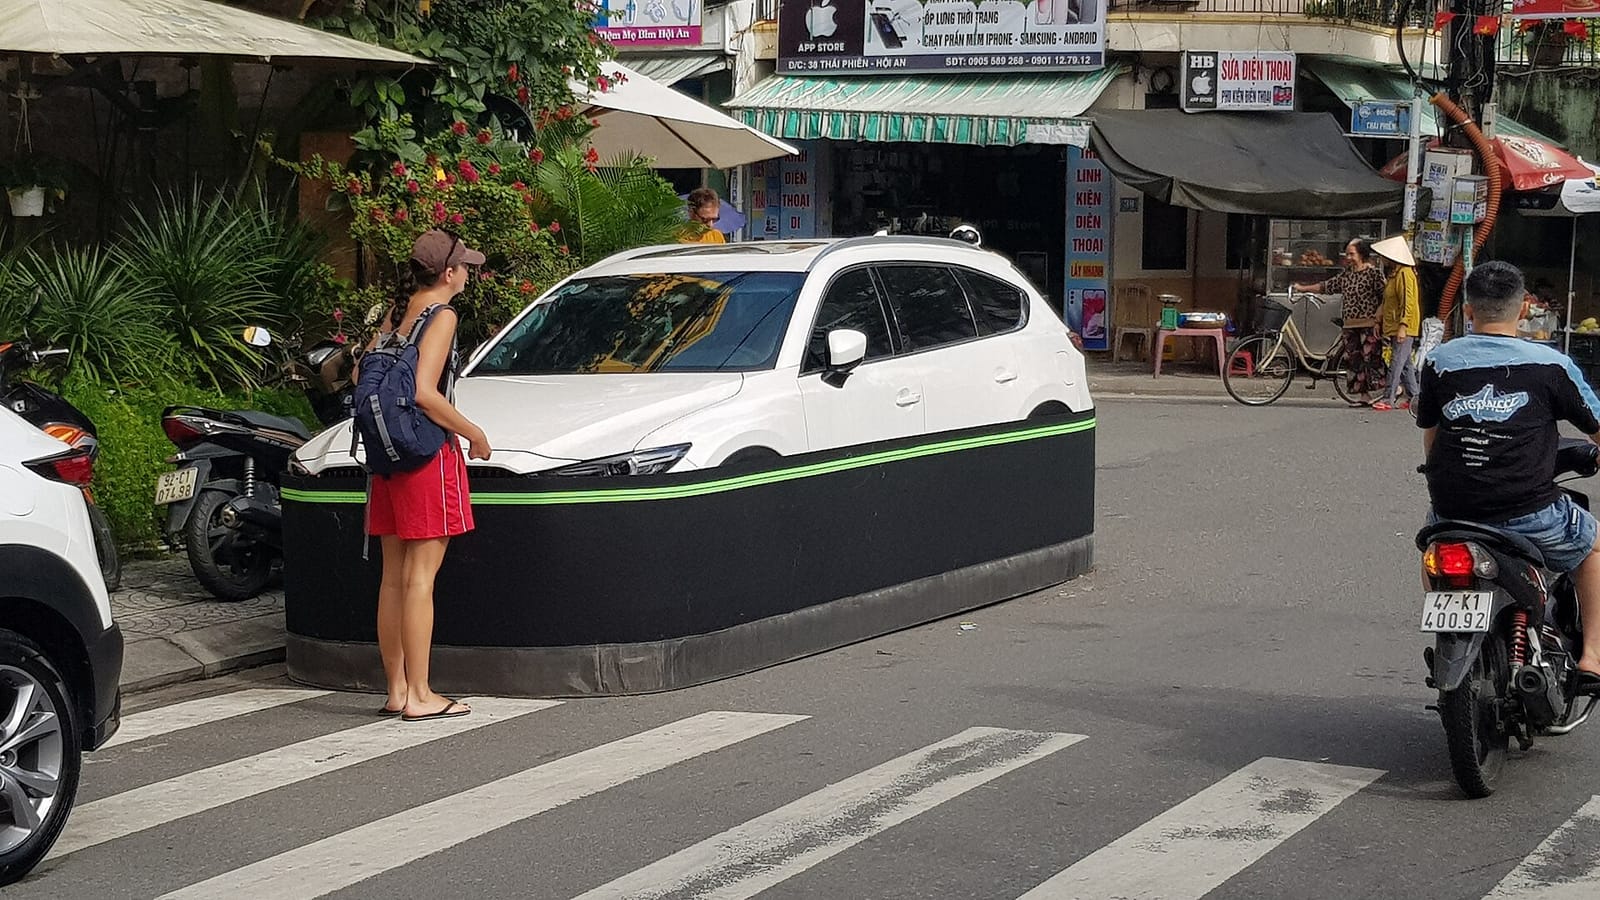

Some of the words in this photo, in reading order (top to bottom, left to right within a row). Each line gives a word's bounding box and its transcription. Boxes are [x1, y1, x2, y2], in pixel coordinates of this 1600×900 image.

[975, 11, 999, 24] TRANG
[986, 33, 1013, 46] IPHONE
[1020, 32, 1057, 45] SAMSUNG
[1064, 31, 1097, 45] ANDROID
[798, 43, 816, 53] APP
[817, 42, 845, 52] STORE
[893, 58, 906, 67] AN
[1031, 55, 1051, 65] 0901
[1190, 55, 1215, 68] HB
[1076, 168, 1102, 182] LINH
[1076, 189, 1102, 208] KIỆN
[1072, 238, 1103, 255] THOẠI
[1433, 593, 1480, 610] 47-K1
[1424, 612, 1485, 629] 400.92
